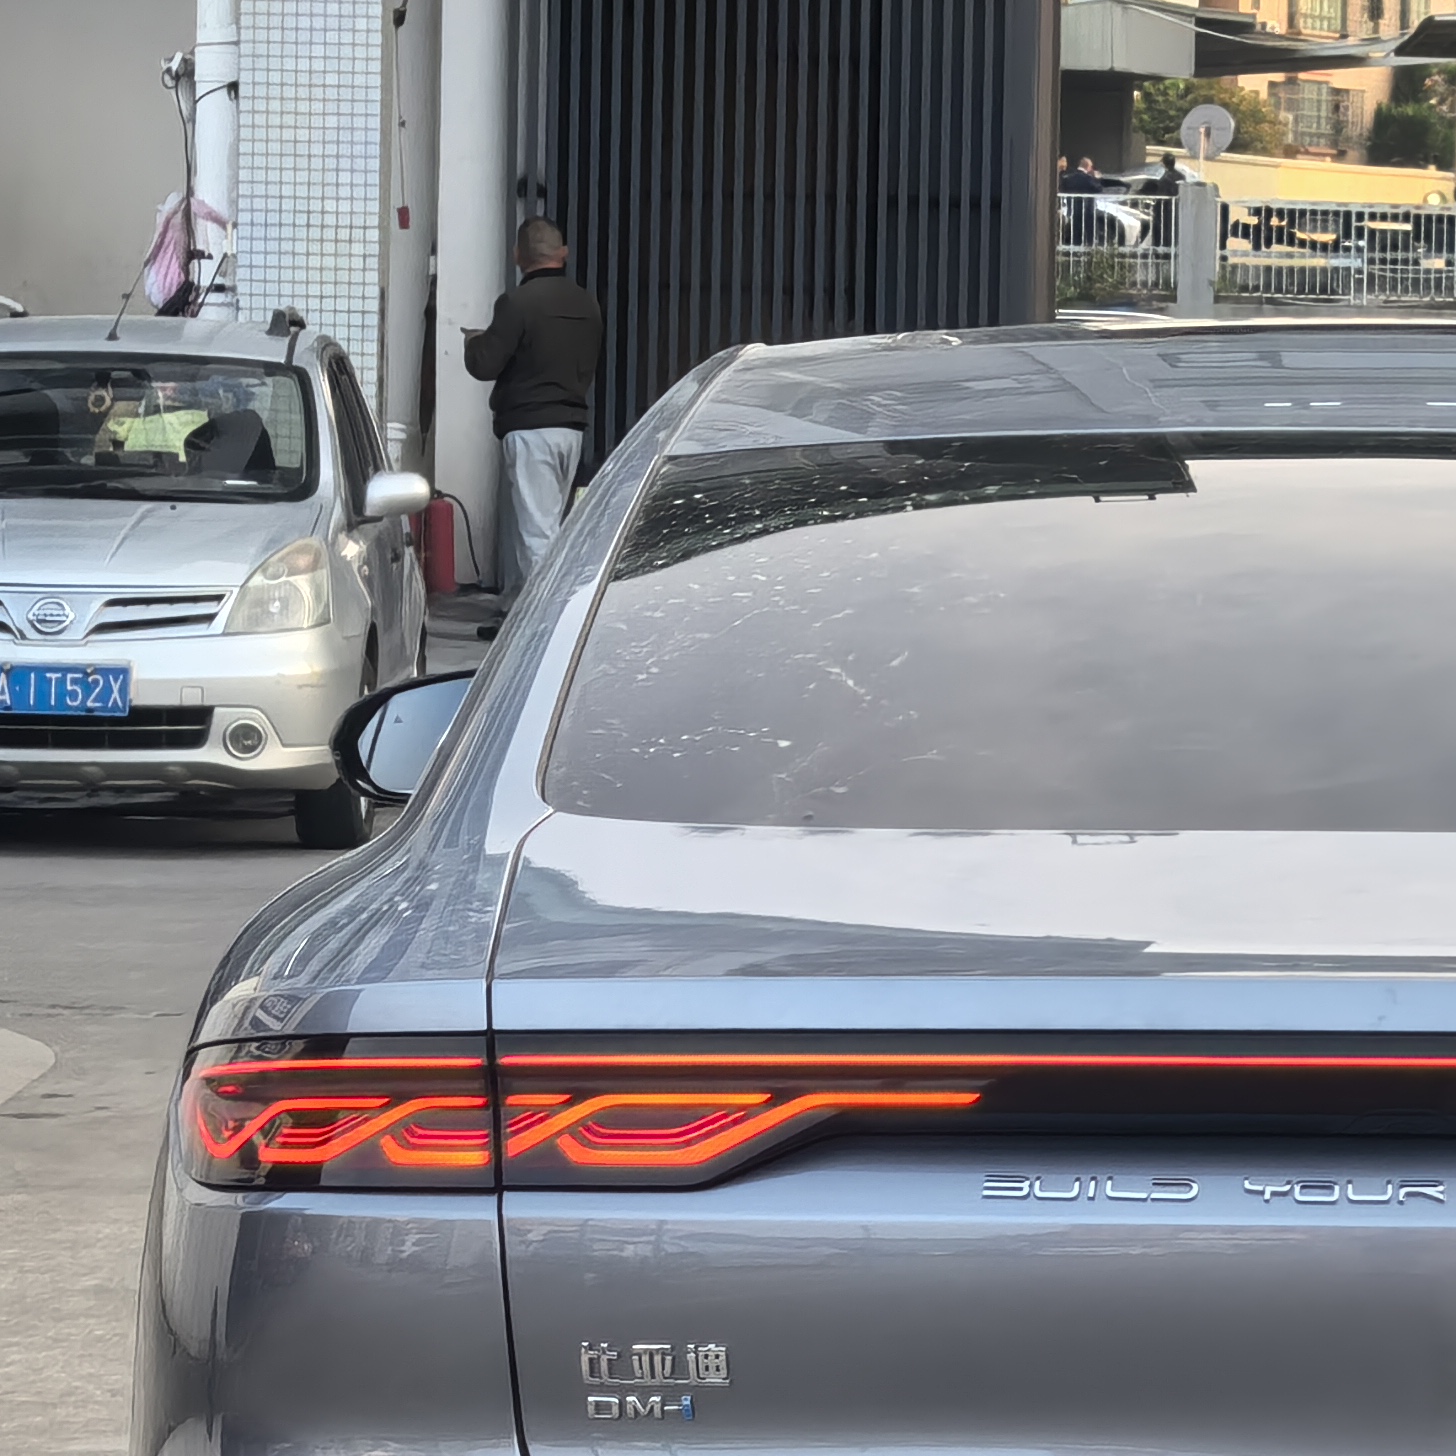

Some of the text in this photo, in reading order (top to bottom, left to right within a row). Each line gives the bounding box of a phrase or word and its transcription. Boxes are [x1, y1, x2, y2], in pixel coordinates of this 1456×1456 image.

[981, 1173, 1200, 1201] BUILD
[1243, 1177, 1447, 1205] YOUR
[580, 1341, 731, 1386] 比亚迪
